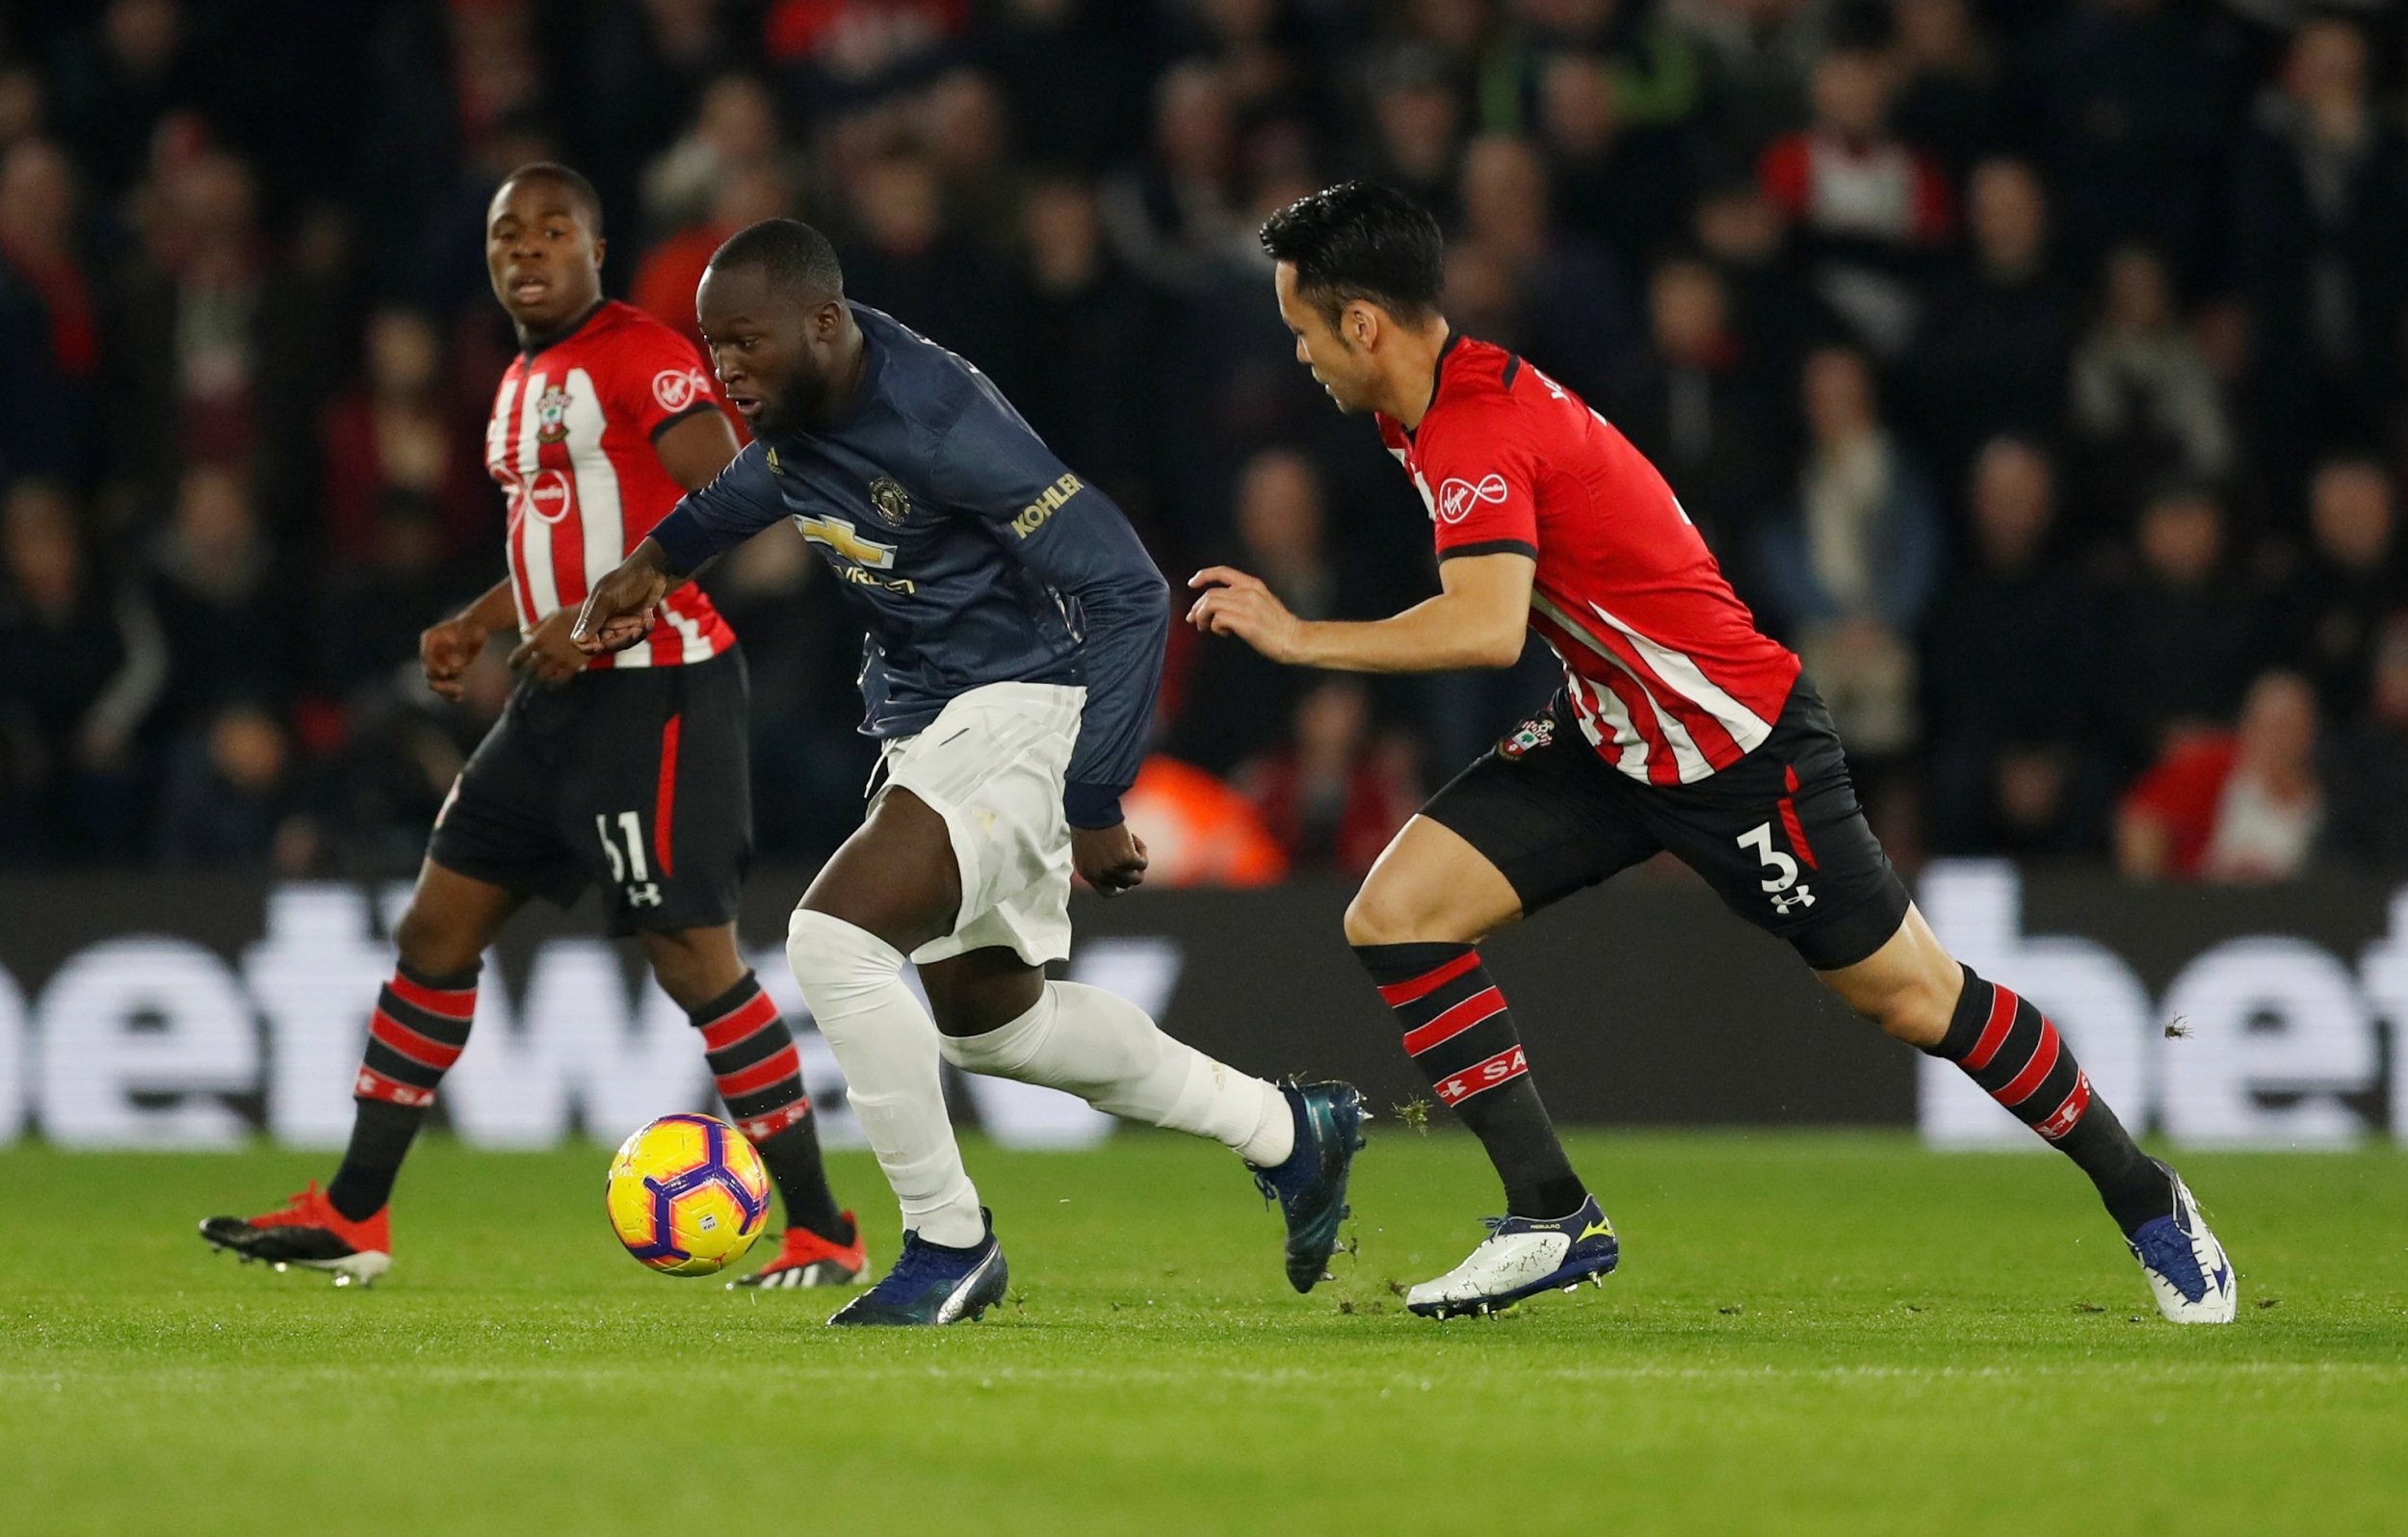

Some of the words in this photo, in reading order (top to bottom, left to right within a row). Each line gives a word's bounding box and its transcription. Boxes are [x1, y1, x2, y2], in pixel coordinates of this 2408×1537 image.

[1010, 473, 1085, 539] KOHLER
[1736, 821, 1798, 893] 3
[1919, 858, 2408, 1153] be
